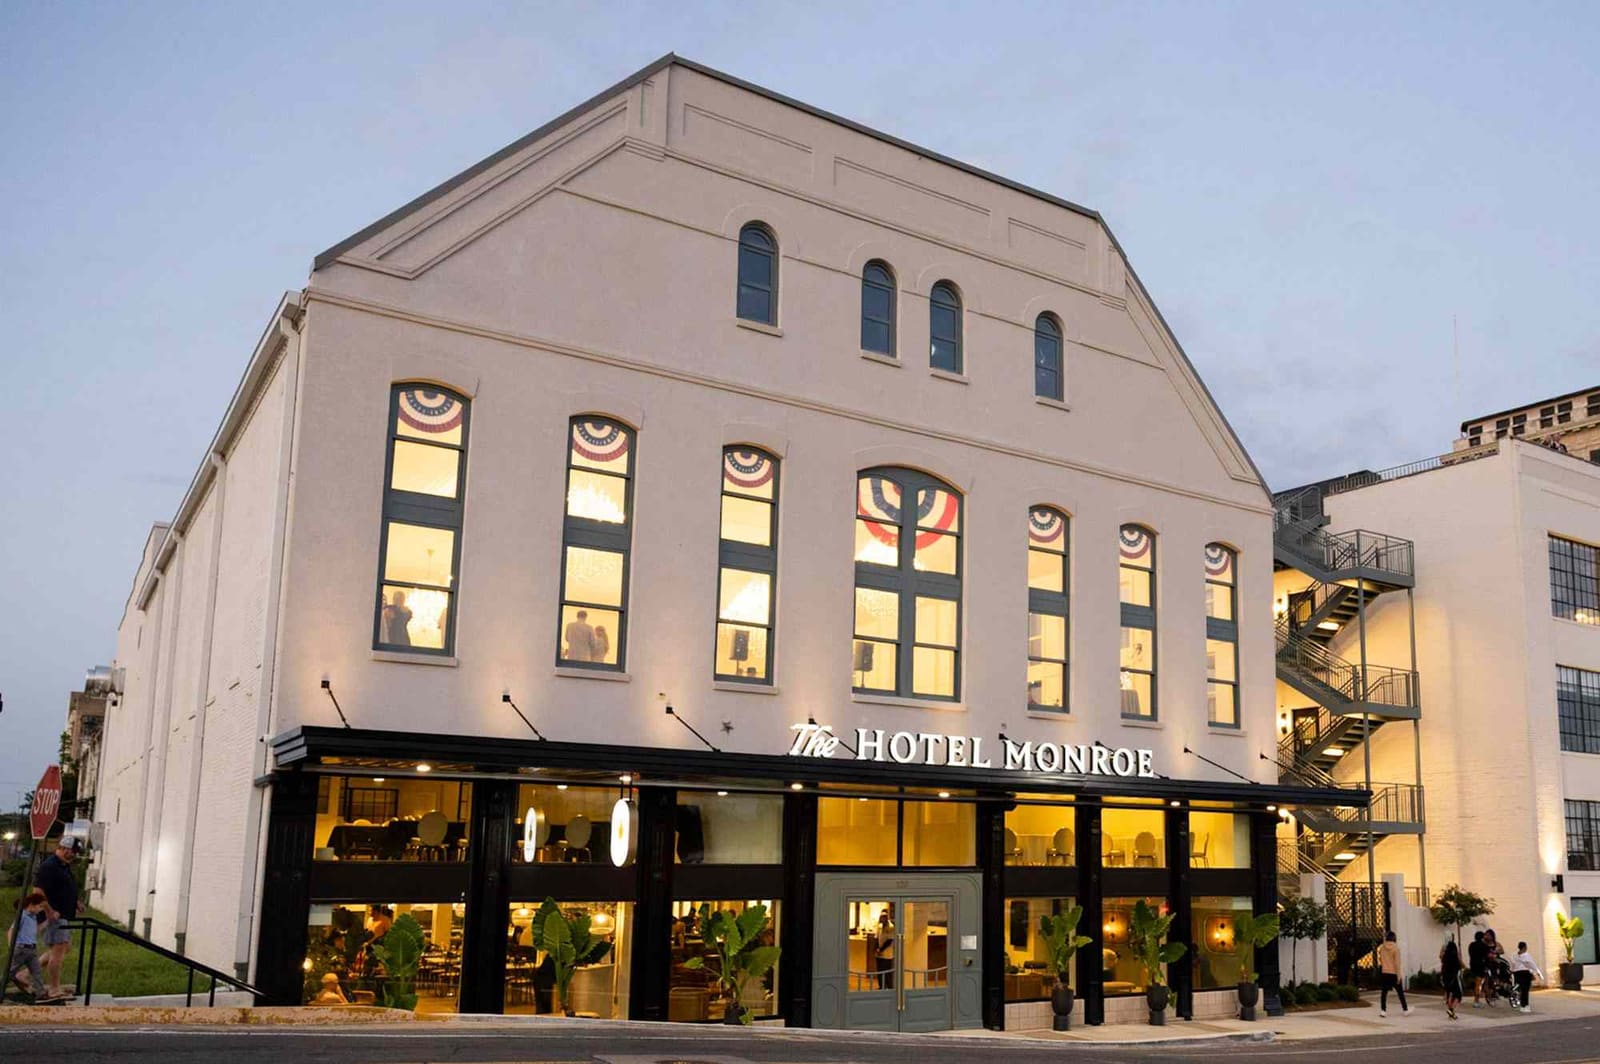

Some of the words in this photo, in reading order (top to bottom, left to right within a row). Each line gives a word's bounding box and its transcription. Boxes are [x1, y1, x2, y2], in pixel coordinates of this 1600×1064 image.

[789, 723, 839, 757] The
[856, 728, 991, 768] HOTEL
[1005, 740, 1154, 777] MONROE
[34, 788, 60, 815] STOP
